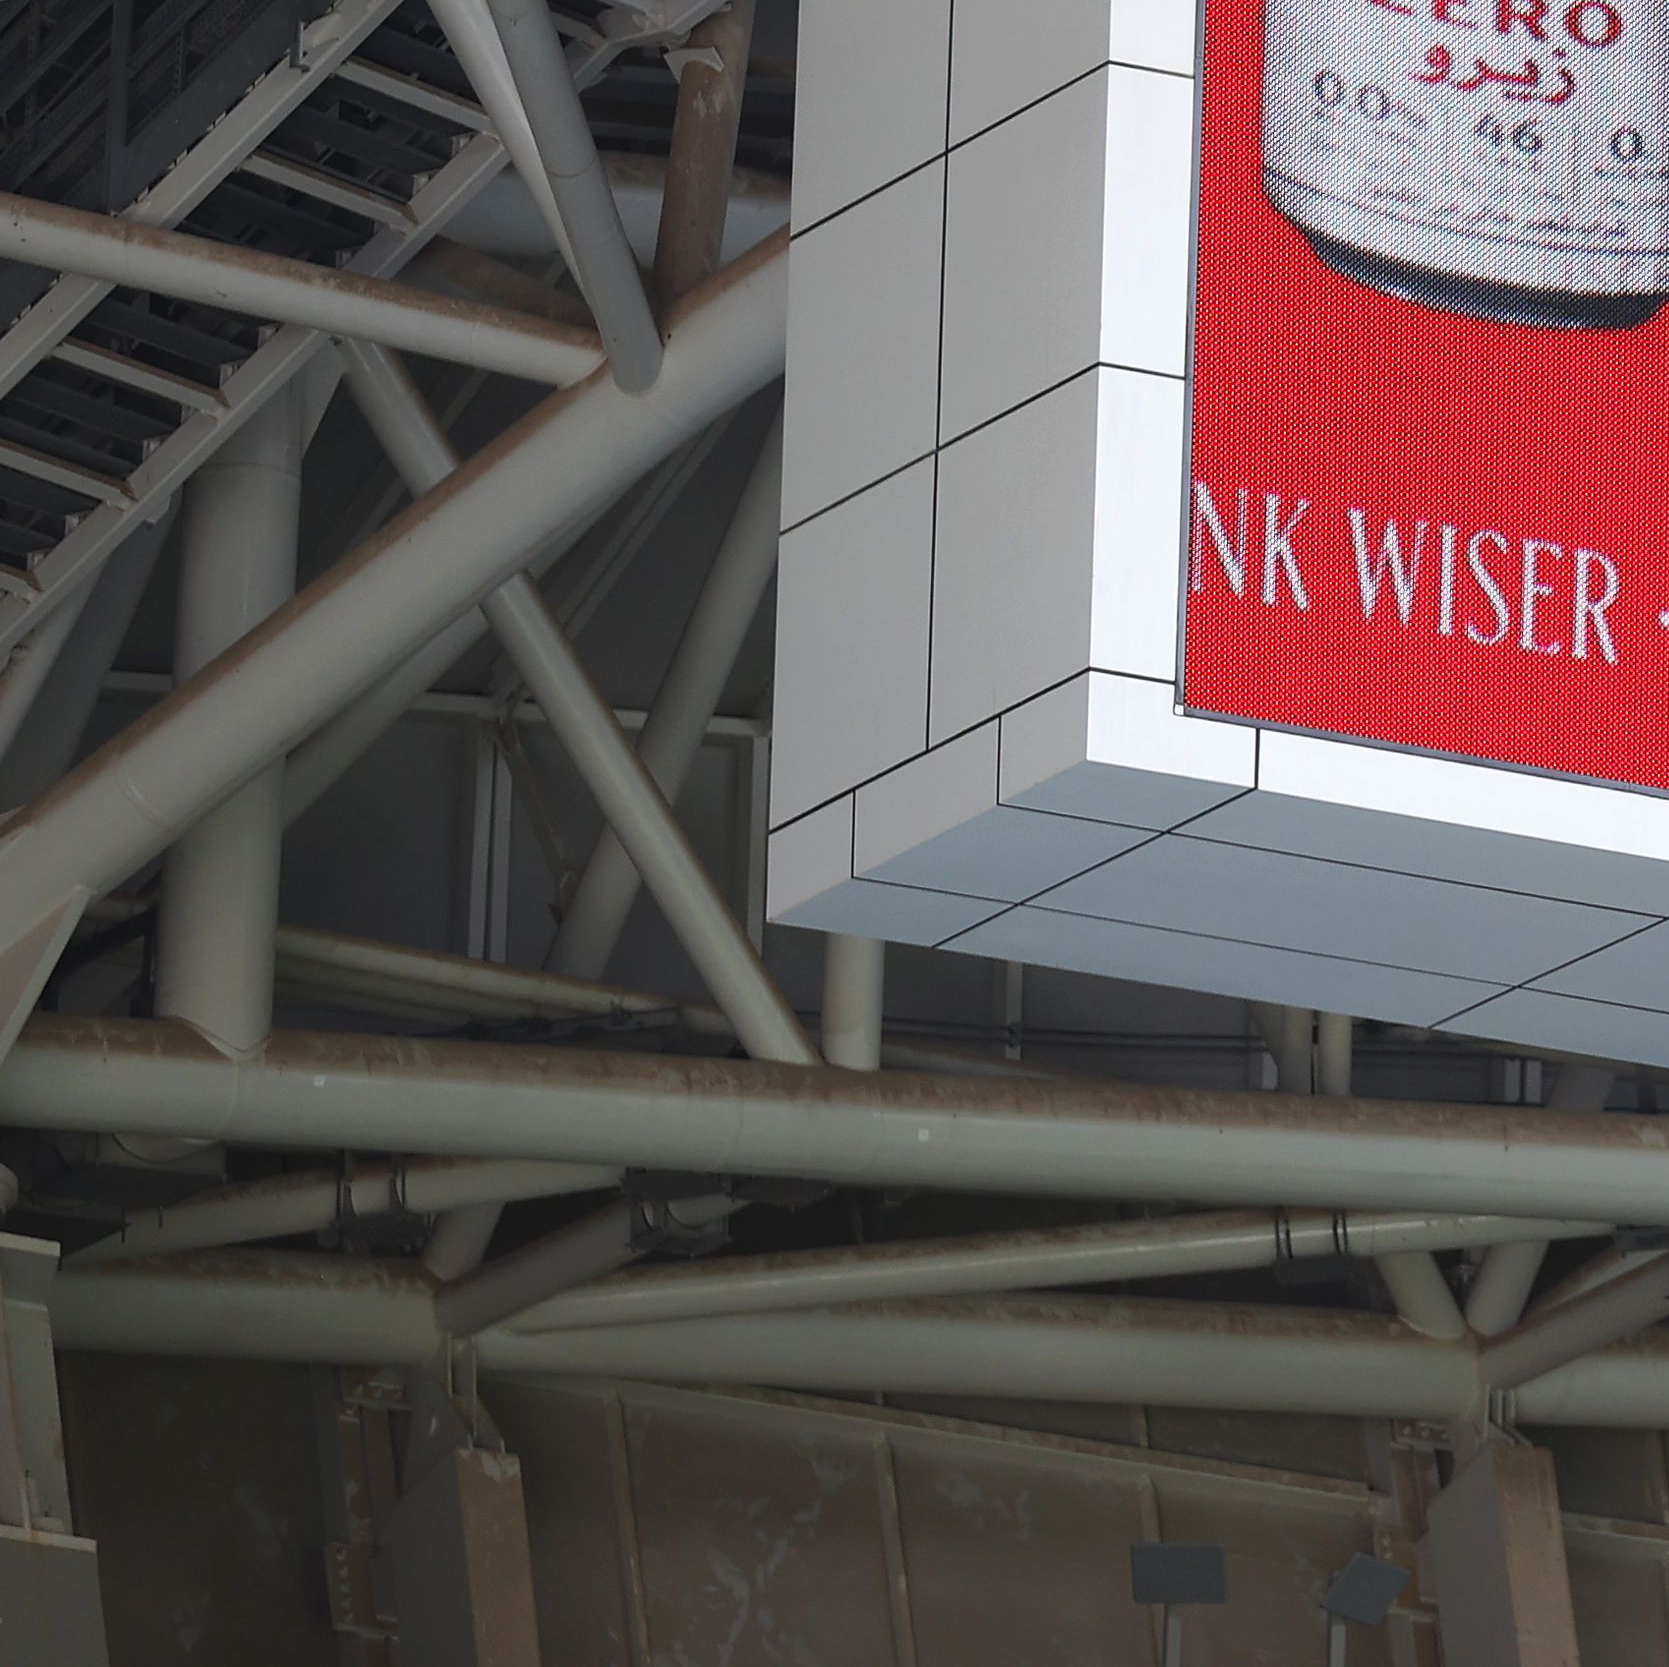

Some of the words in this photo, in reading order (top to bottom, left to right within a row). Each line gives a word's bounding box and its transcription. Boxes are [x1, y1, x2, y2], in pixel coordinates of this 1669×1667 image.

[1410, 43, 1577, 105] زيرو
[1473, 111, 1544, 155] 46
[1192, 481, 1312, 612] NK
[1347, 507, 1621, 665] WISER
